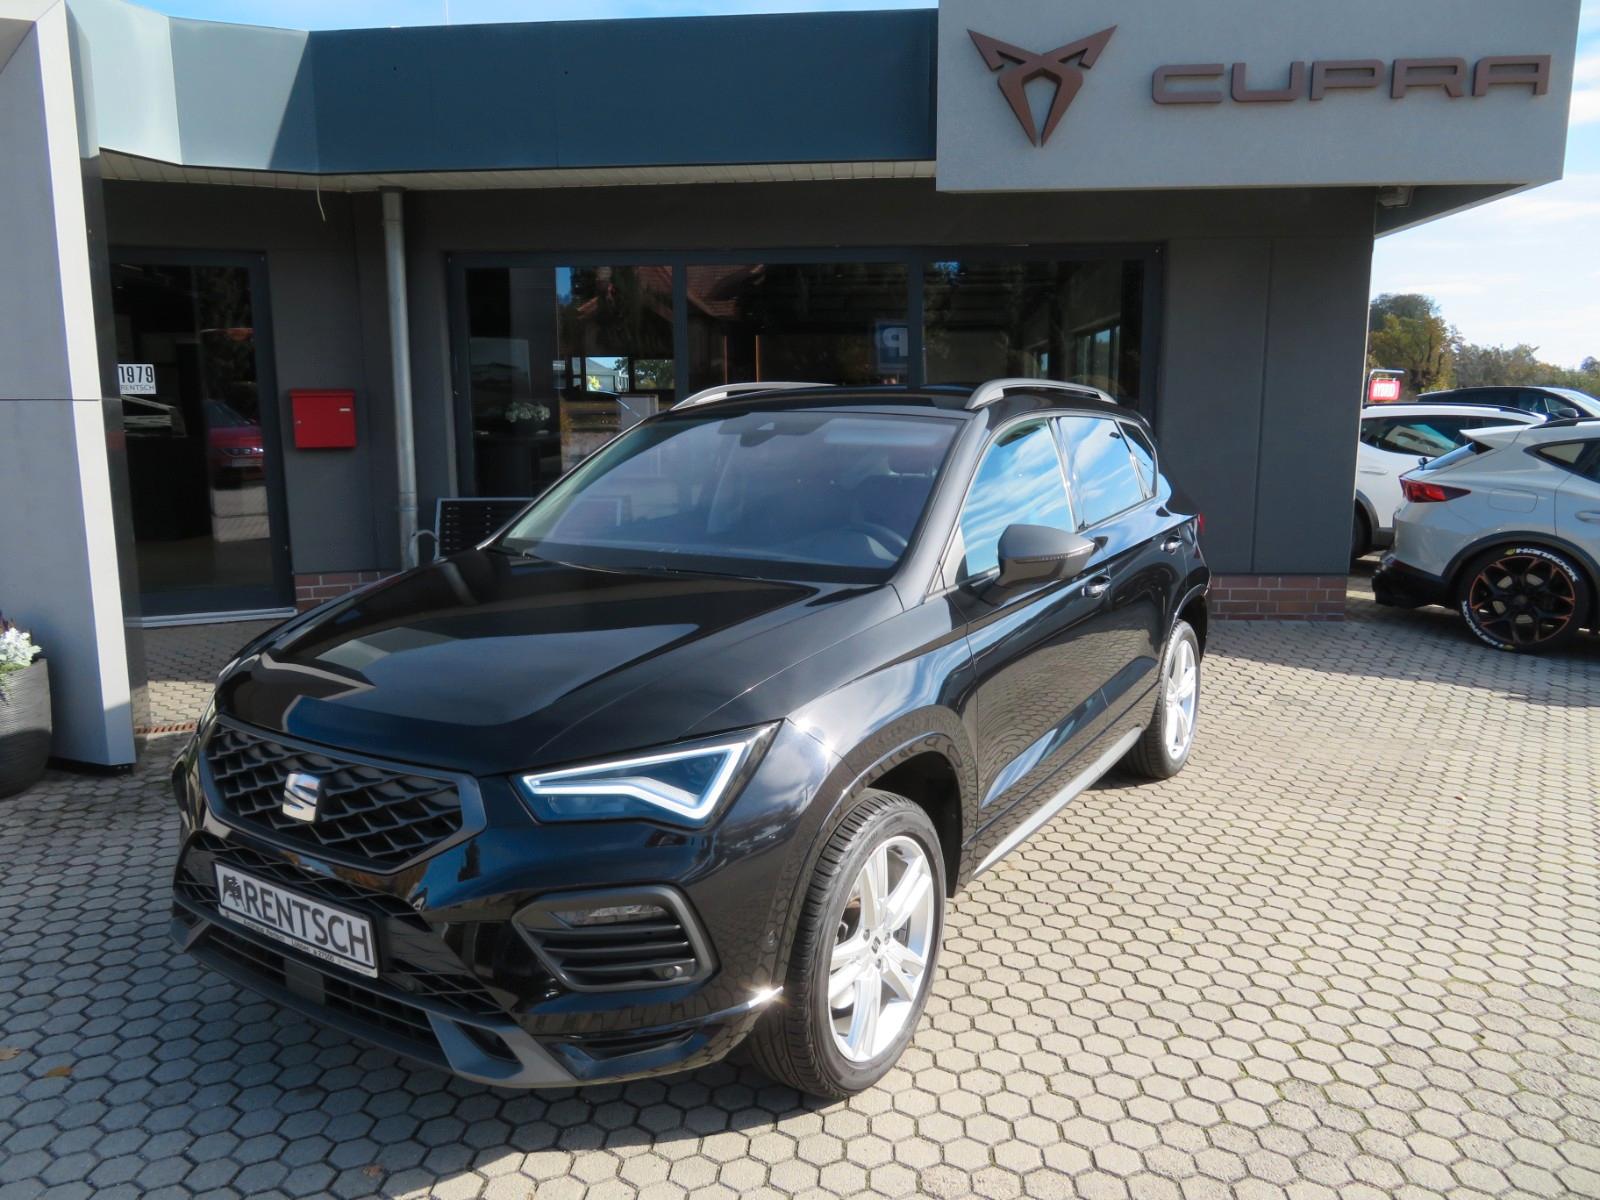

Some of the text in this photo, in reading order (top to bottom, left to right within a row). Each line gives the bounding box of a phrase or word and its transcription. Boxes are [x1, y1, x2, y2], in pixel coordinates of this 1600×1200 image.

[1152, 55, 1551, 105] CUPRA
[118, 366, 154, 383] 1979
[243, 880, 371, 962] RENTSCH
